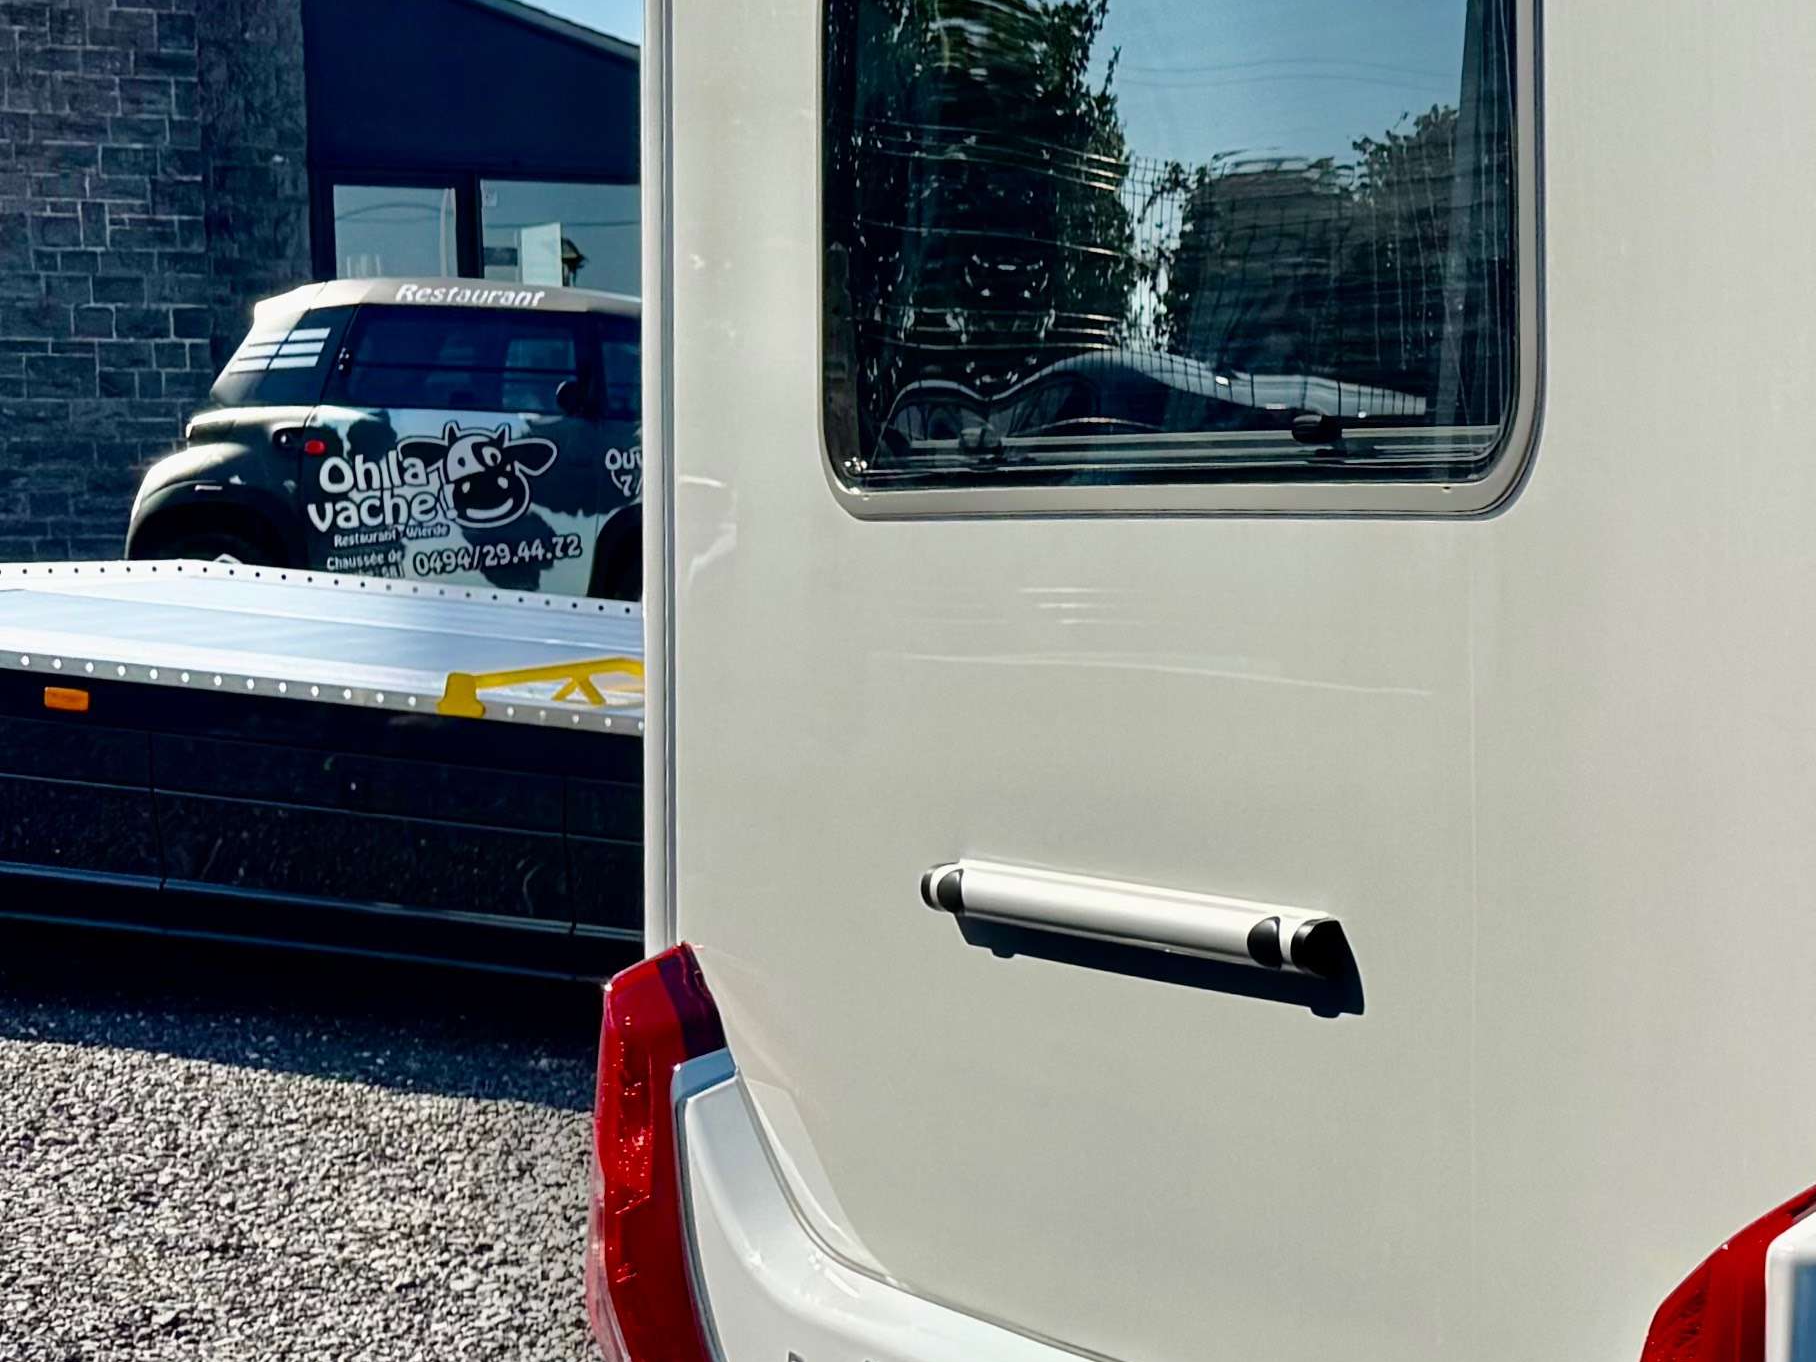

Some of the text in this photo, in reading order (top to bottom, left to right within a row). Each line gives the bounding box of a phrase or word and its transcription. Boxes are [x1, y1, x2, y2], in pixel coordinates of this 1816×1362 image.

[395, 283, 546, 307] Restaurant
[334, 528, 397, 548] Restaurant
[414, 534, 581, 576] 0494/29.44.72
